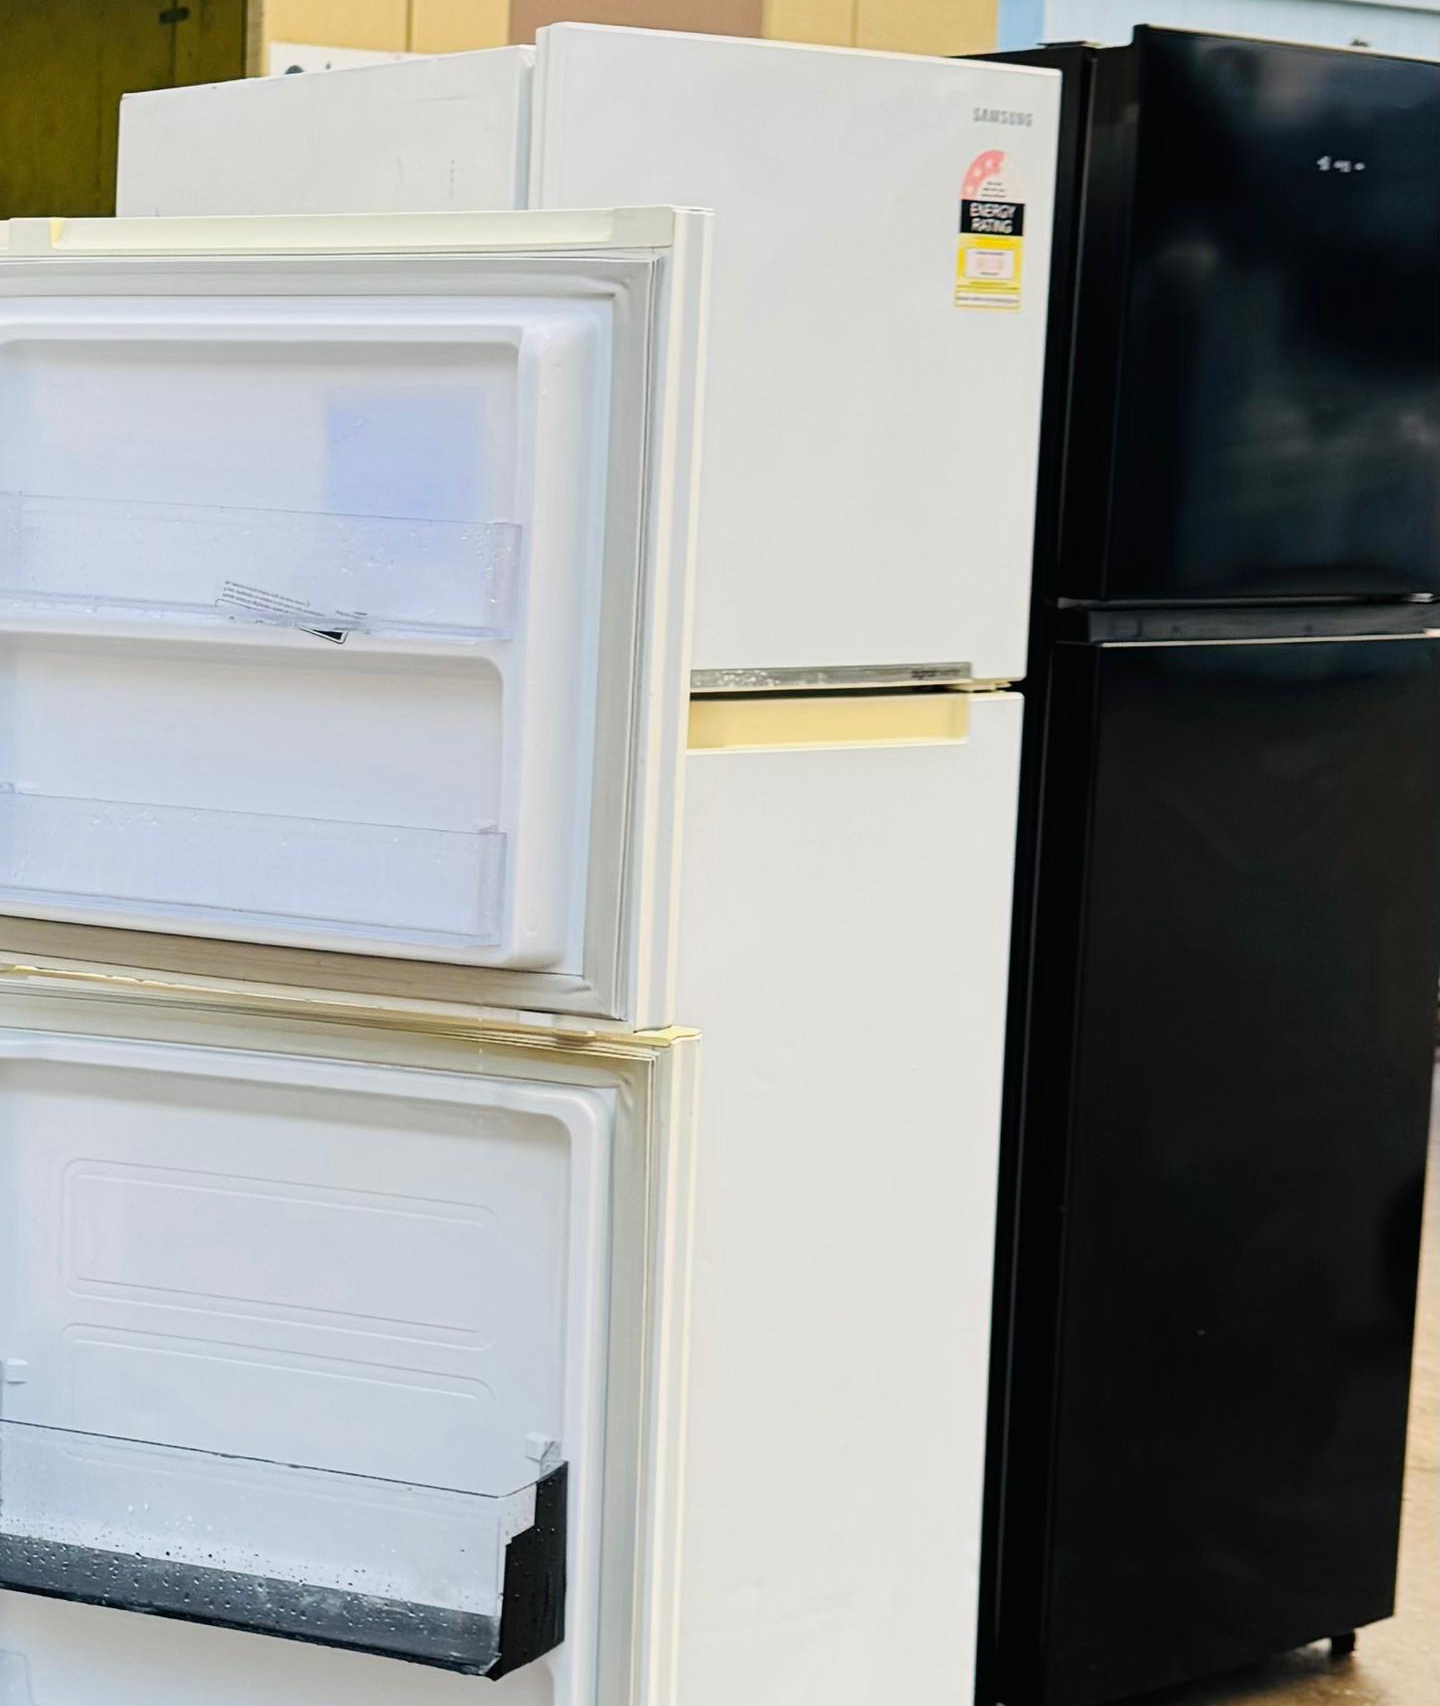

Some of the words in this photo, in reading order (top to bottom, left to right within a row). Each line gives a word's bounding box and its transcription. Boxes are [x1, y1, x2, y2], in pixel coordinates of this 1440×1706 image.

[972, 107, 1033, 127] SAMSUNG
[969, 202, 1016, 219] ENERGY
[971, 217, 1013, 234] RATING
